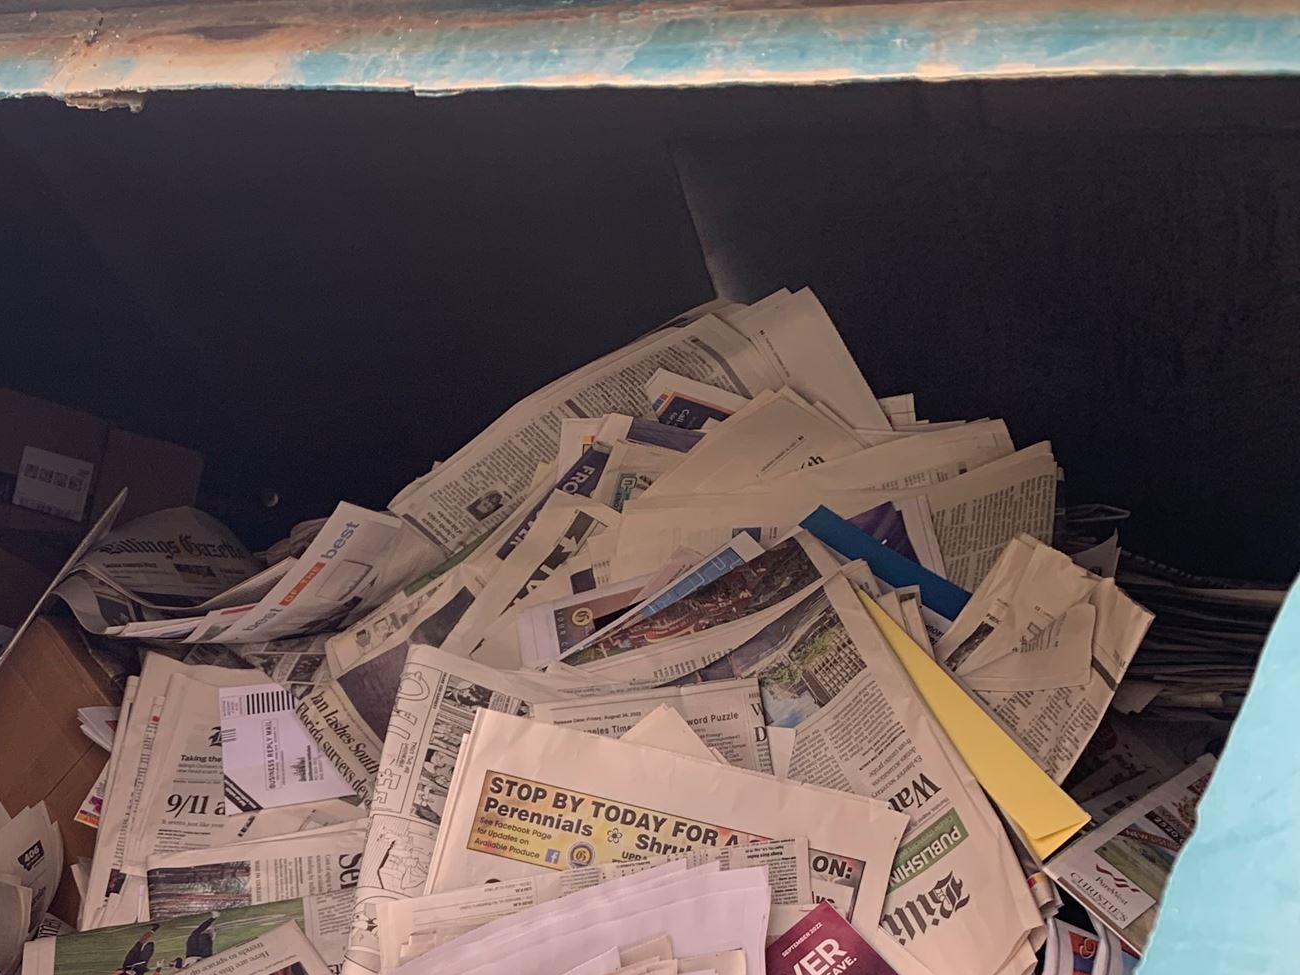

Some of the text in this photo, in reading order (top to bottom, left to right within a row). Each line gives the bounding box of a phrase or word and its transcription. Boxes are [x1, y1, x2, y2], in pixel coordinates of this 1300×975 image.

[323, 521, 360, 560] best
[711, 711, 739, 722] Puzzle
[181, 754, 207, 762] Taking
[165, 793, 209, 818] 9/11
[484, 797, 593, 837] Perennials
[490, 777, 718, 847] STOP BY TODAY FOR
[479, 816, 552, 841] See Facebook Page
[487, 829, 518, 845] Updates
[474, 837, 540, 860] Available Produce
[813, 856, 854, 879] ON:
[782, 922, 823, 957] SEPTEMBER 2022
